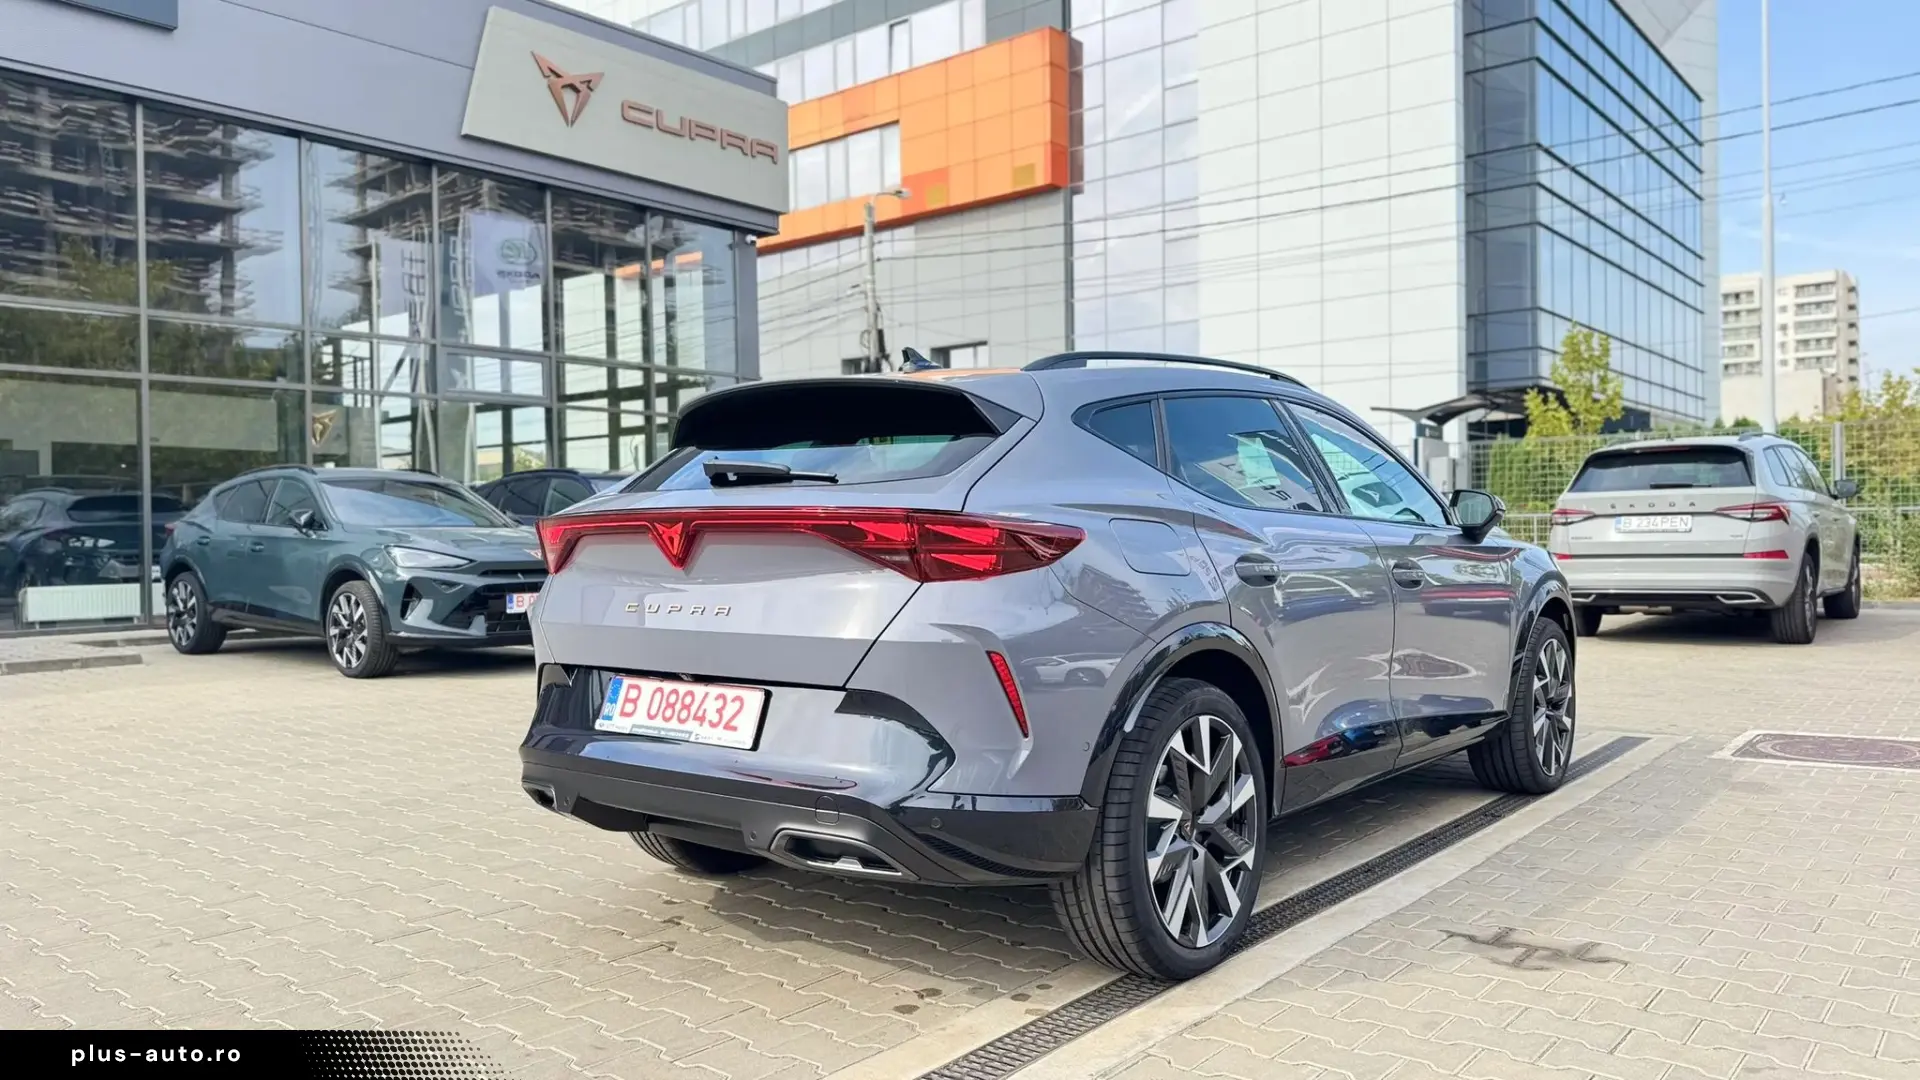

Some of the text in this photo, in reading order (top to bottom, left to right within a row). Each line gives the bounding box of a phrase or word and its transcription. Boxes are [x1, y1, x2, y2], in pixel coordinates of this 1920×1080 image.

[621, 100, 778, 165] CUPRA
[625, 602, 731, 616] CUPRA
[619, 683, 745, 732] B 088432
